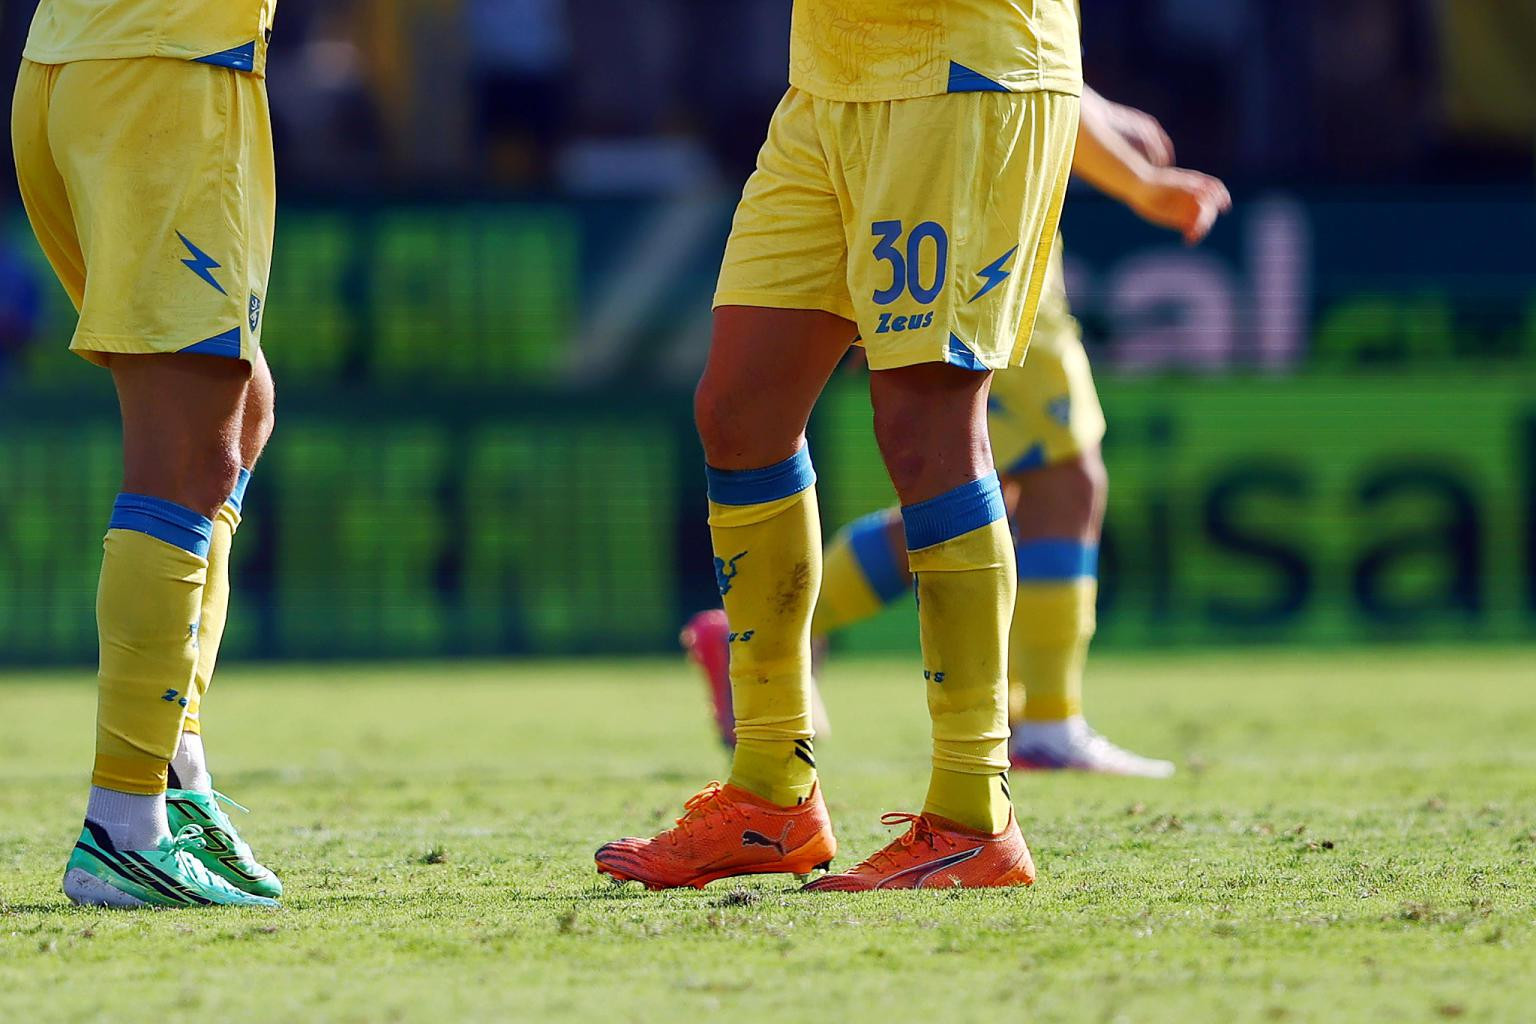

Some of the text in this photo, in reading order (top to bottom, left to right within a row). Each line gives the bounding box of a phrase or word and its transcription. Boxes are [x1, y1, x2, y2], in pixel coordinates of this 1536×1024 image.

[871, 219, 949, 305] 30
[874, 310, 935, 334] Zeus
[1102, 404, 1536, 631] isal
